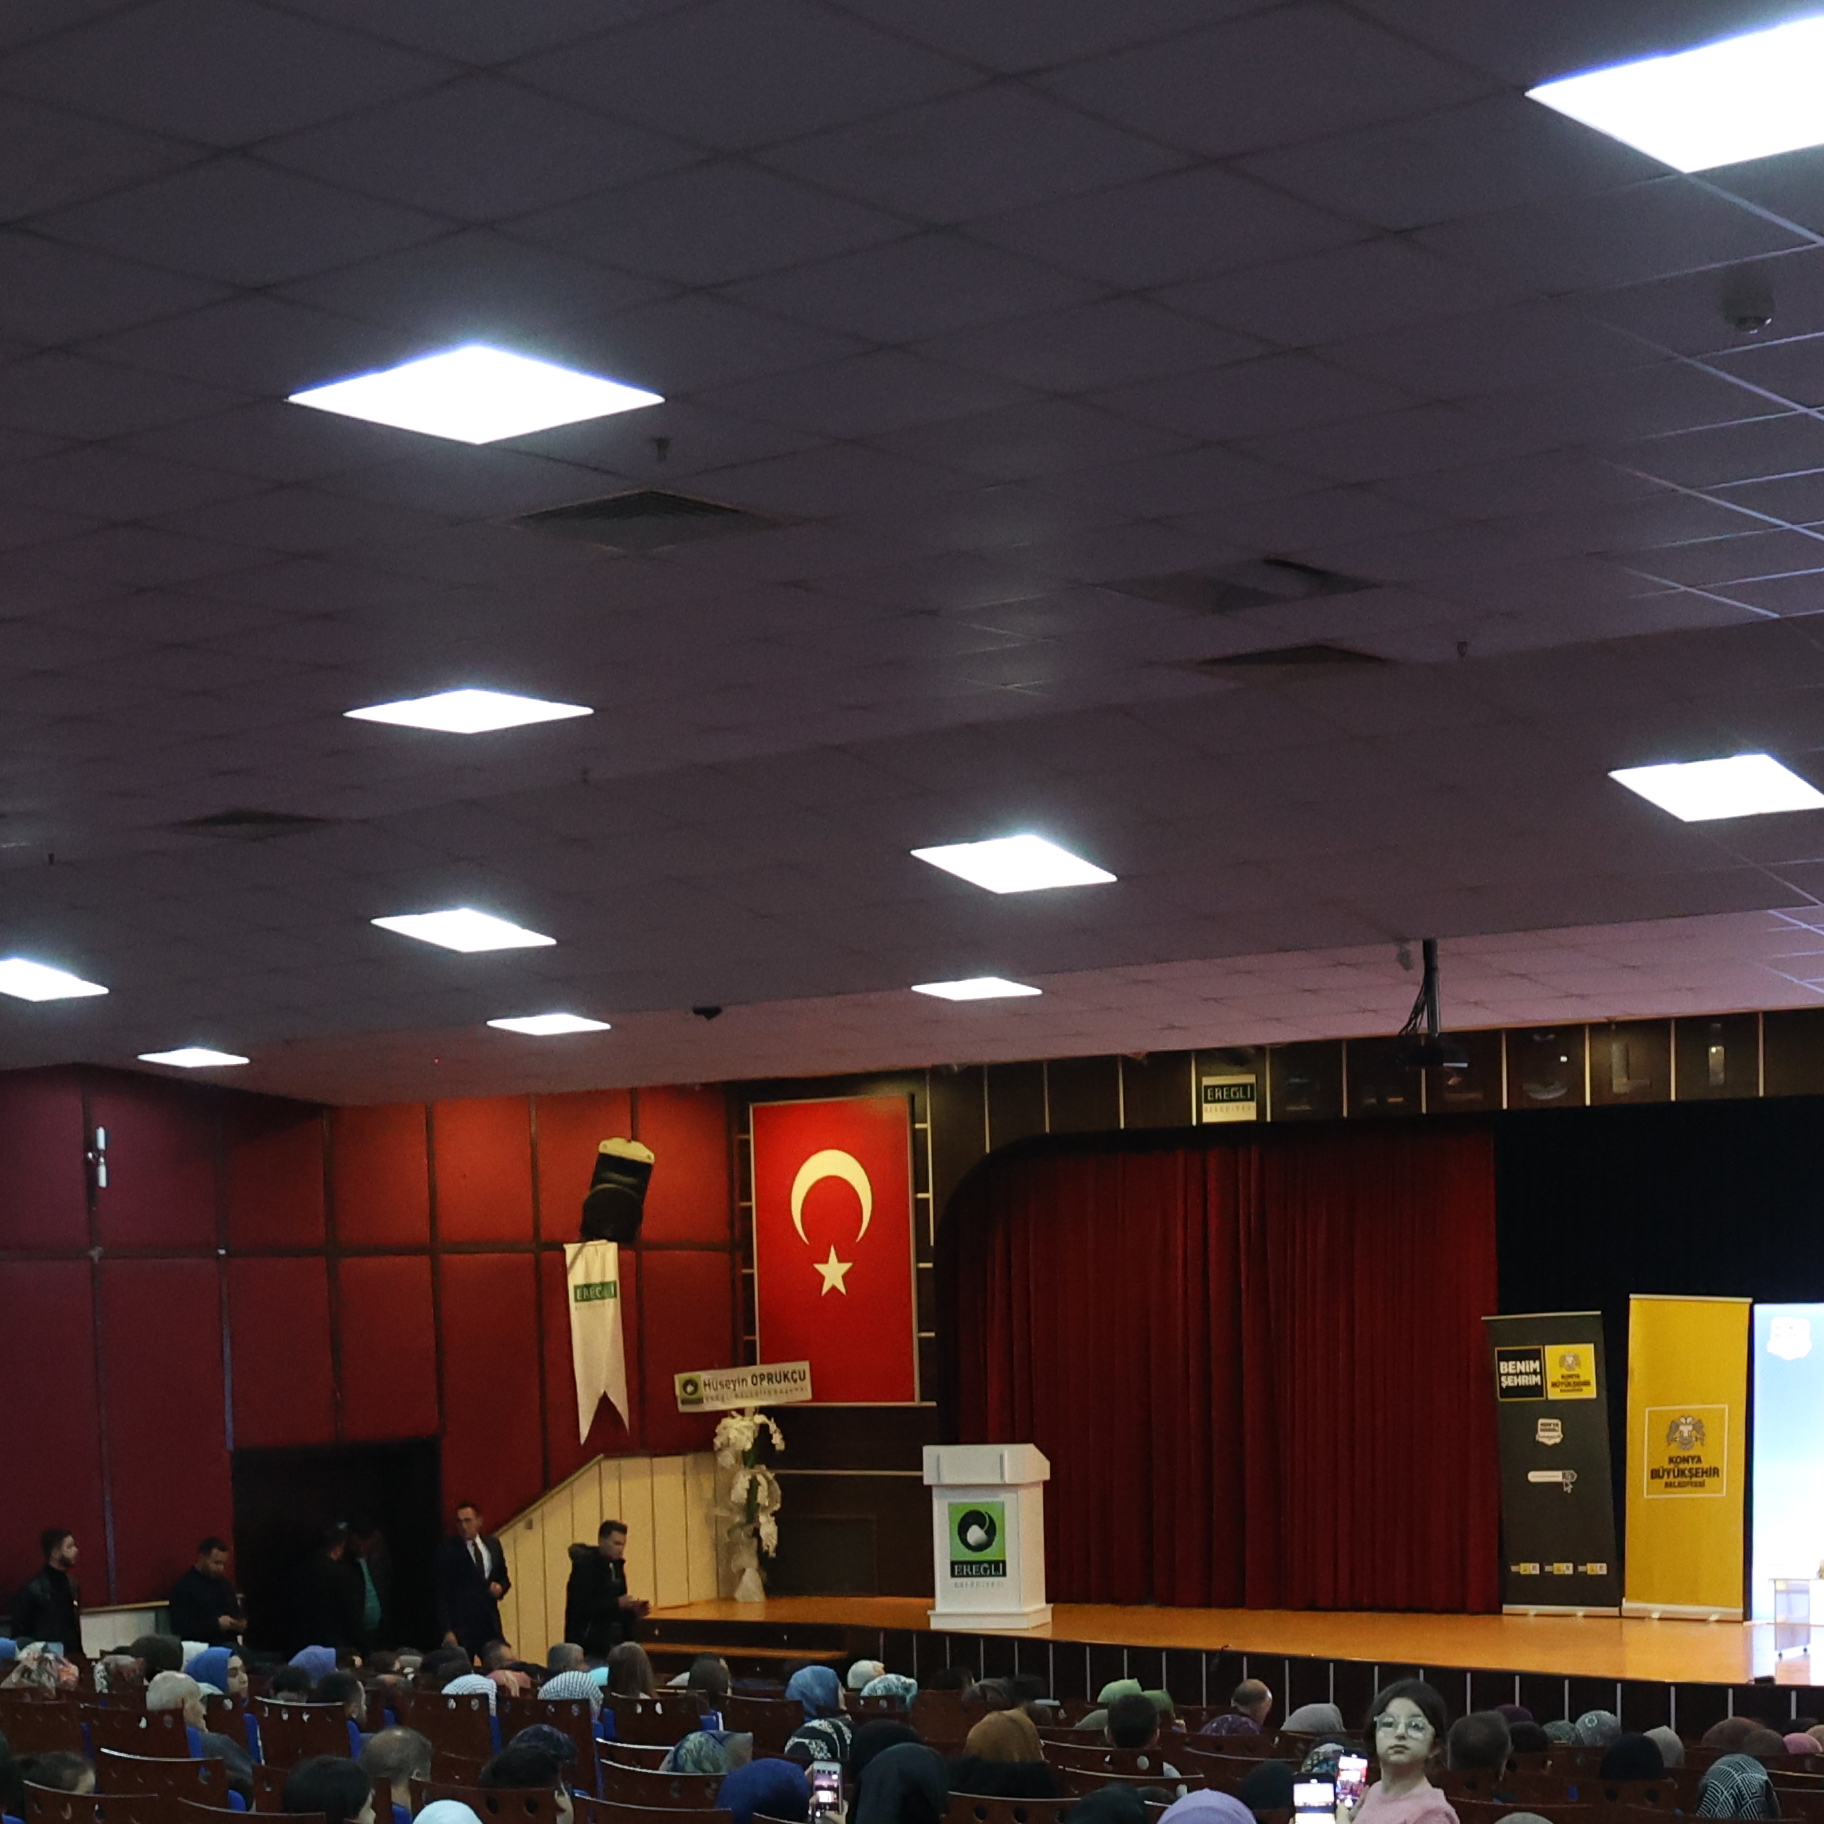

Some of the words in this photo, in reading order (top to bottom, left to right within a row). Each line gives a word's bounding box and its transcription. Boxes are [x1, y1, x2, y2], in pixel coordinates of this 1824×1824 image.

[1499, 1360, 1540, 1374] BENİM
[1501, 1374, 1541, 1388] ŞEHRİM
[1668, 1455, 1703, 1464] KONYA
[1650, 1466, 1720, 1480] BÜYÜKŞEHİR
